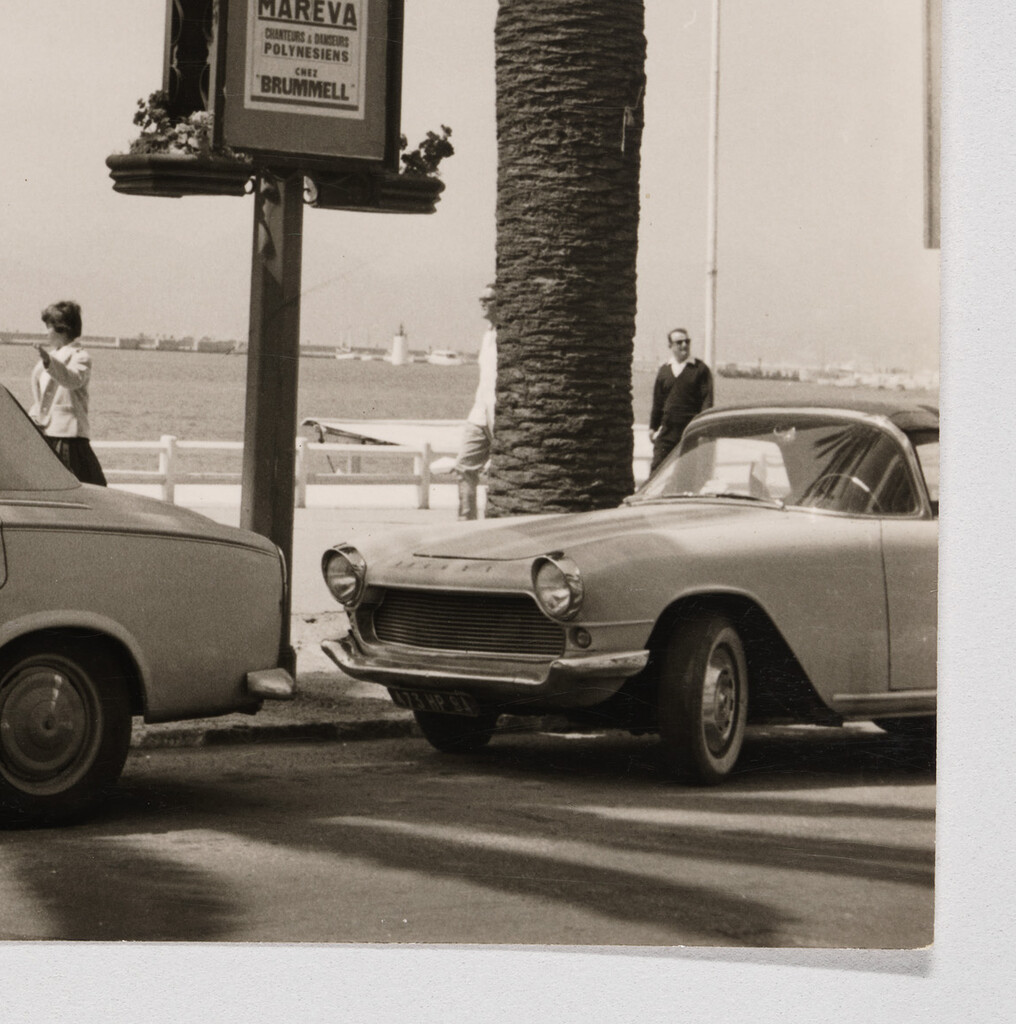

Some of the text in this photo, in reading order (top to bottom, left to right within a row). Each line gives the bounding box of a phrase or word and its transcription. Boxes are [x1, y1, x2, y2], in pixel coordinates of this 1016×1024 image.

[264, 28, 305, 44] CHANTEURS
[314, 33, 349, 48] DANSEURS
[264, 42, 349, 62] POLYNESIENS
[295, 67, 318, 78] CHEZ
